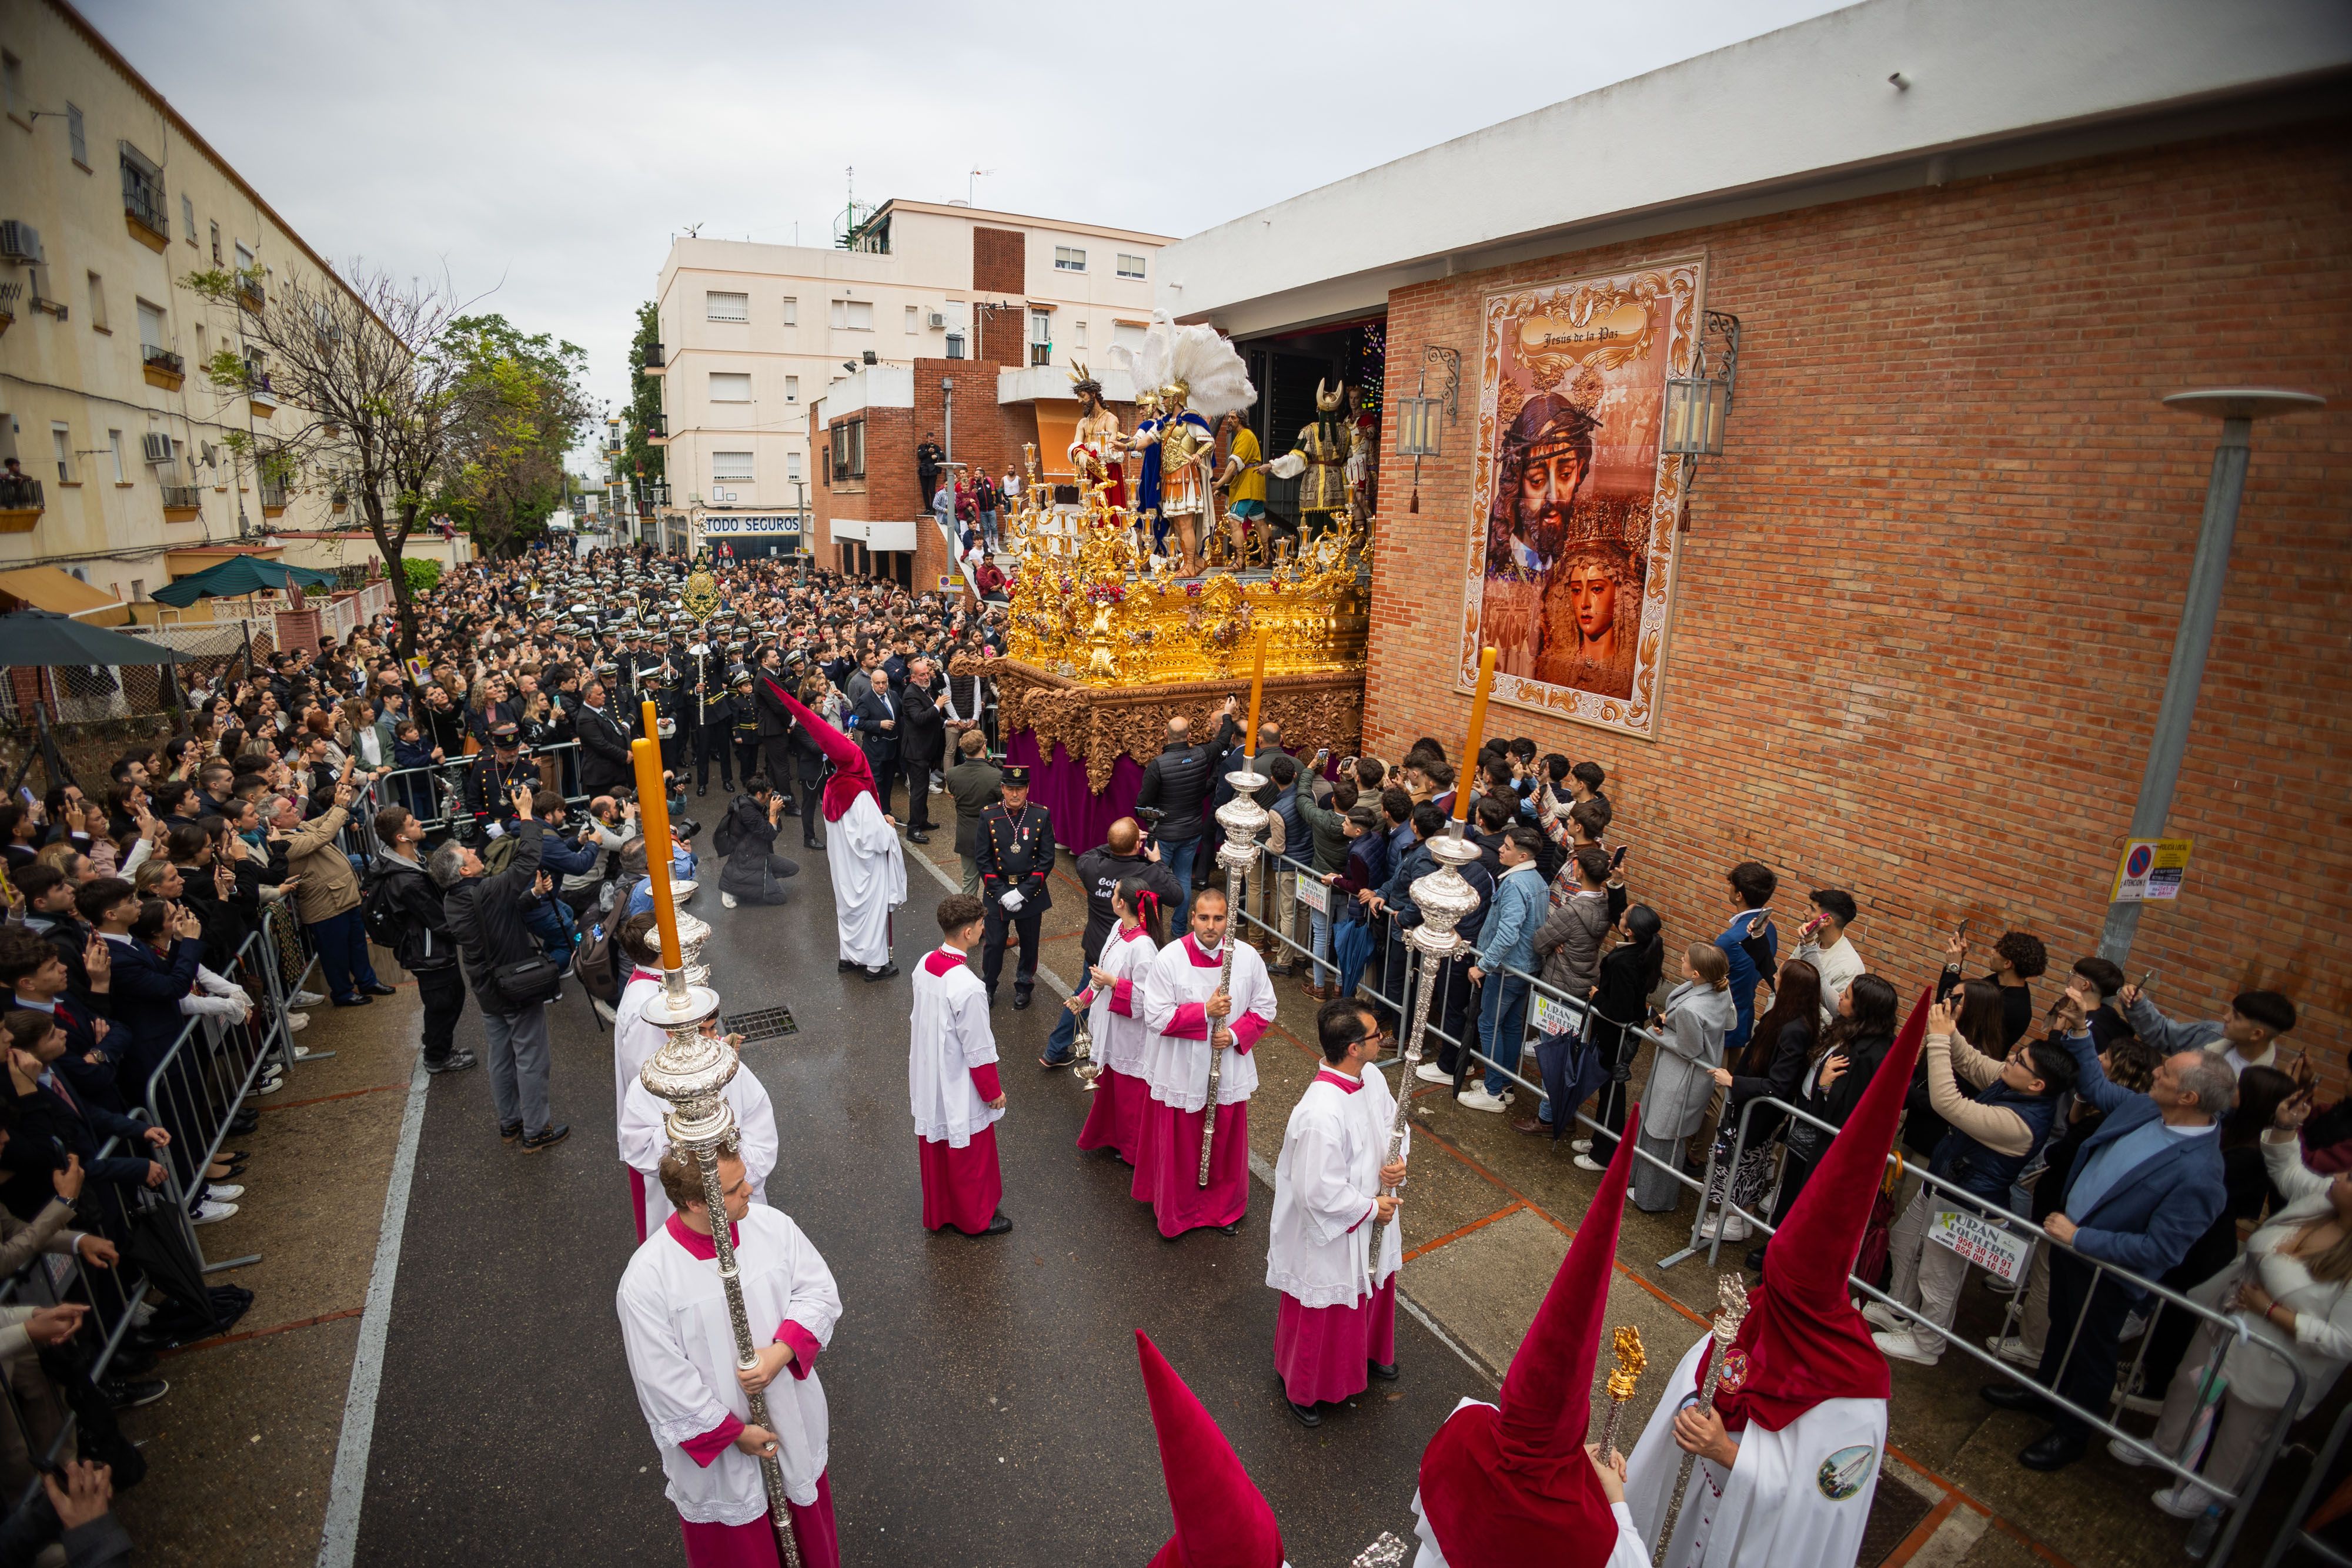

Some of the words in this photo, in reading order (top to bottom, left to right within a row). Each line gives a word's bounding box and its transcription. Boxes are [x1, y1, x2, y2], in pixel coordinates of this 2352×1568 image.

[1543, 332, 1571, 348] Jesús
[1574, 333, 1583, 342] de
[1586, 331, 1594, 342] la
[1598, 327, 1618, 343] Paz
[706, 519, 739, 531] TODO
[746, 517, 799, 531] SEGUROS
[1095, 888, 1112, 898] del
[1539, 997, 1571, 1021] DURÁN
[1548, 1020, 1557, 1029] 956
[1548, 1027, 1556, 1035] 856
[1942, 1213, 2000, 1242] DURÁN
[1939, 1219, 2015, 1262] ALQUILERES
[1946, 1231, 1956, 1239] JEREZ
[1957, 1236, 1973, 1249] 956
[1975, 1245, 1986, 1256] 30
[1989, 1252, 1999, 1263] 70
[2001, 1259, 2012, 1269] 91
[1955, 1244, 1971, 1256] 856
[1973, 1253, 1983, 1263] 00
[1986, 1260, 1996, 1271] 16
[1998, 1266, 2010, 1277] 59
